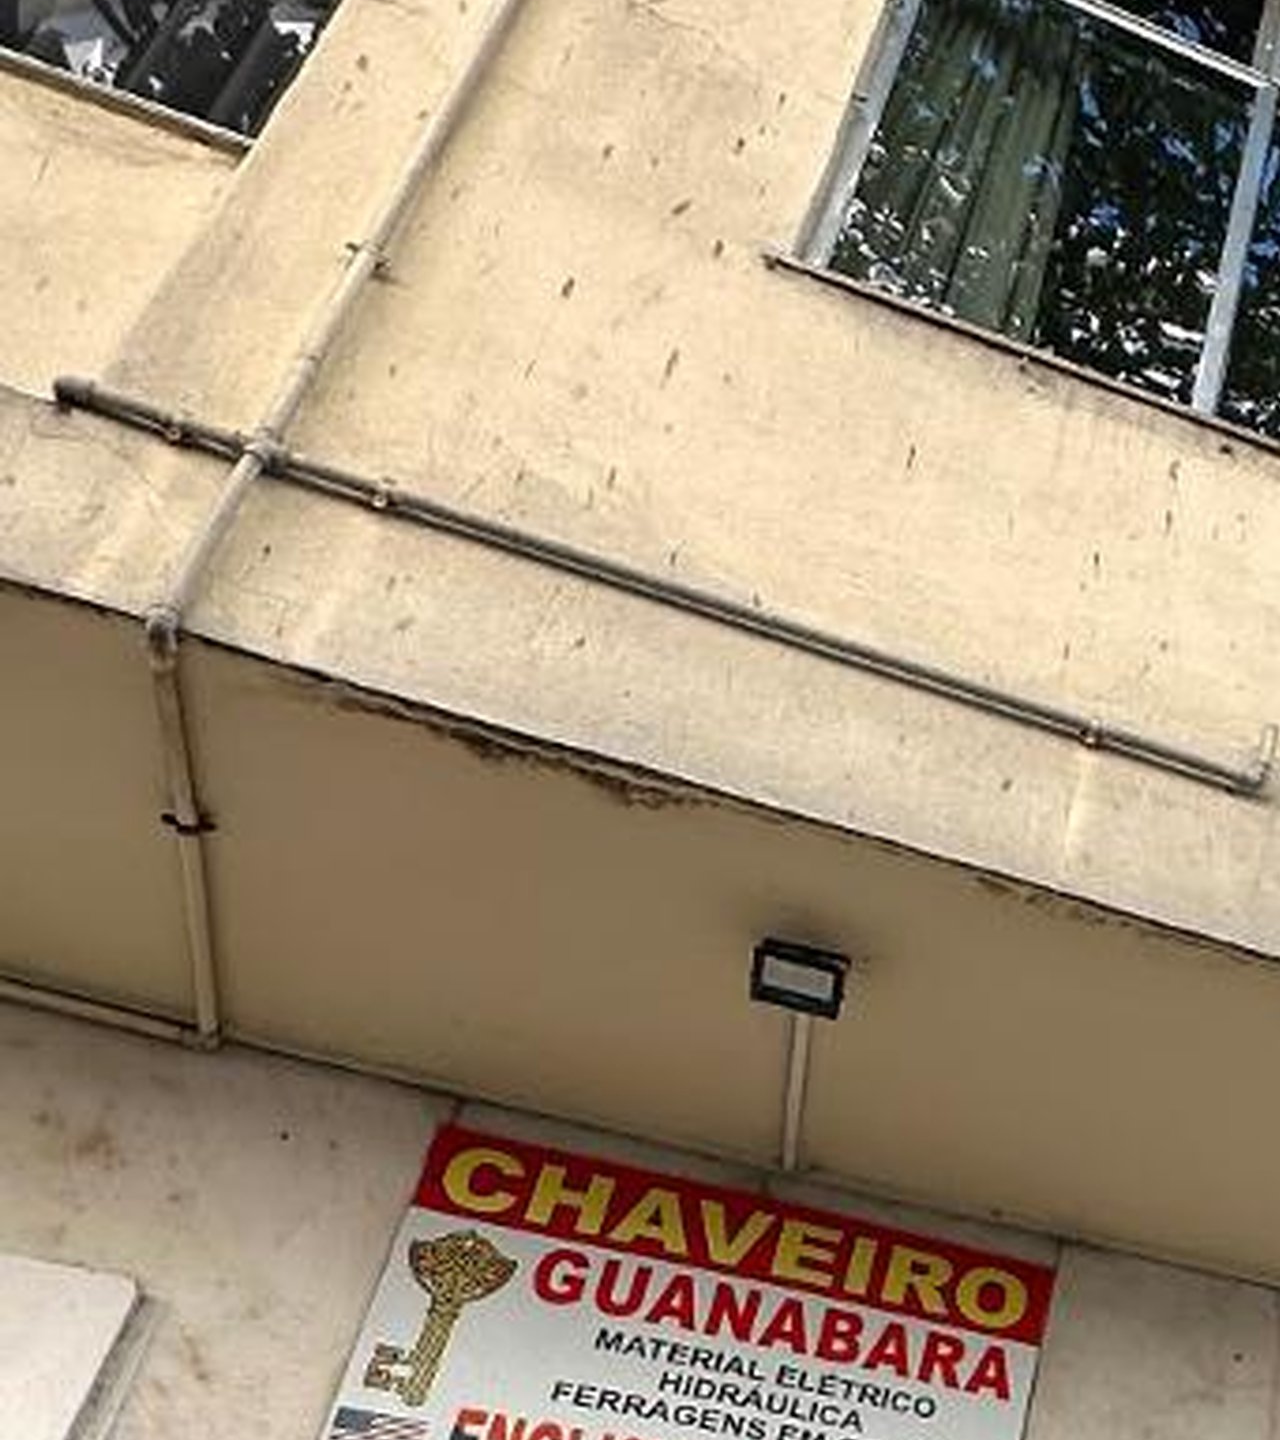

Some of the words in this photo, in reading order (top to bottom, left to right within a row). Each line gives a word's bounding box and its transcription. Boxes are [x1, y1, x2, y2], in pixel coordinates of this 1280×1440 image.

[442, 1148, 1028, 1329] CHAVEIRO
[533, 1249, 1012, 1401] GUANABARA
[594, 1328, 766, 1383] MATERIAL
